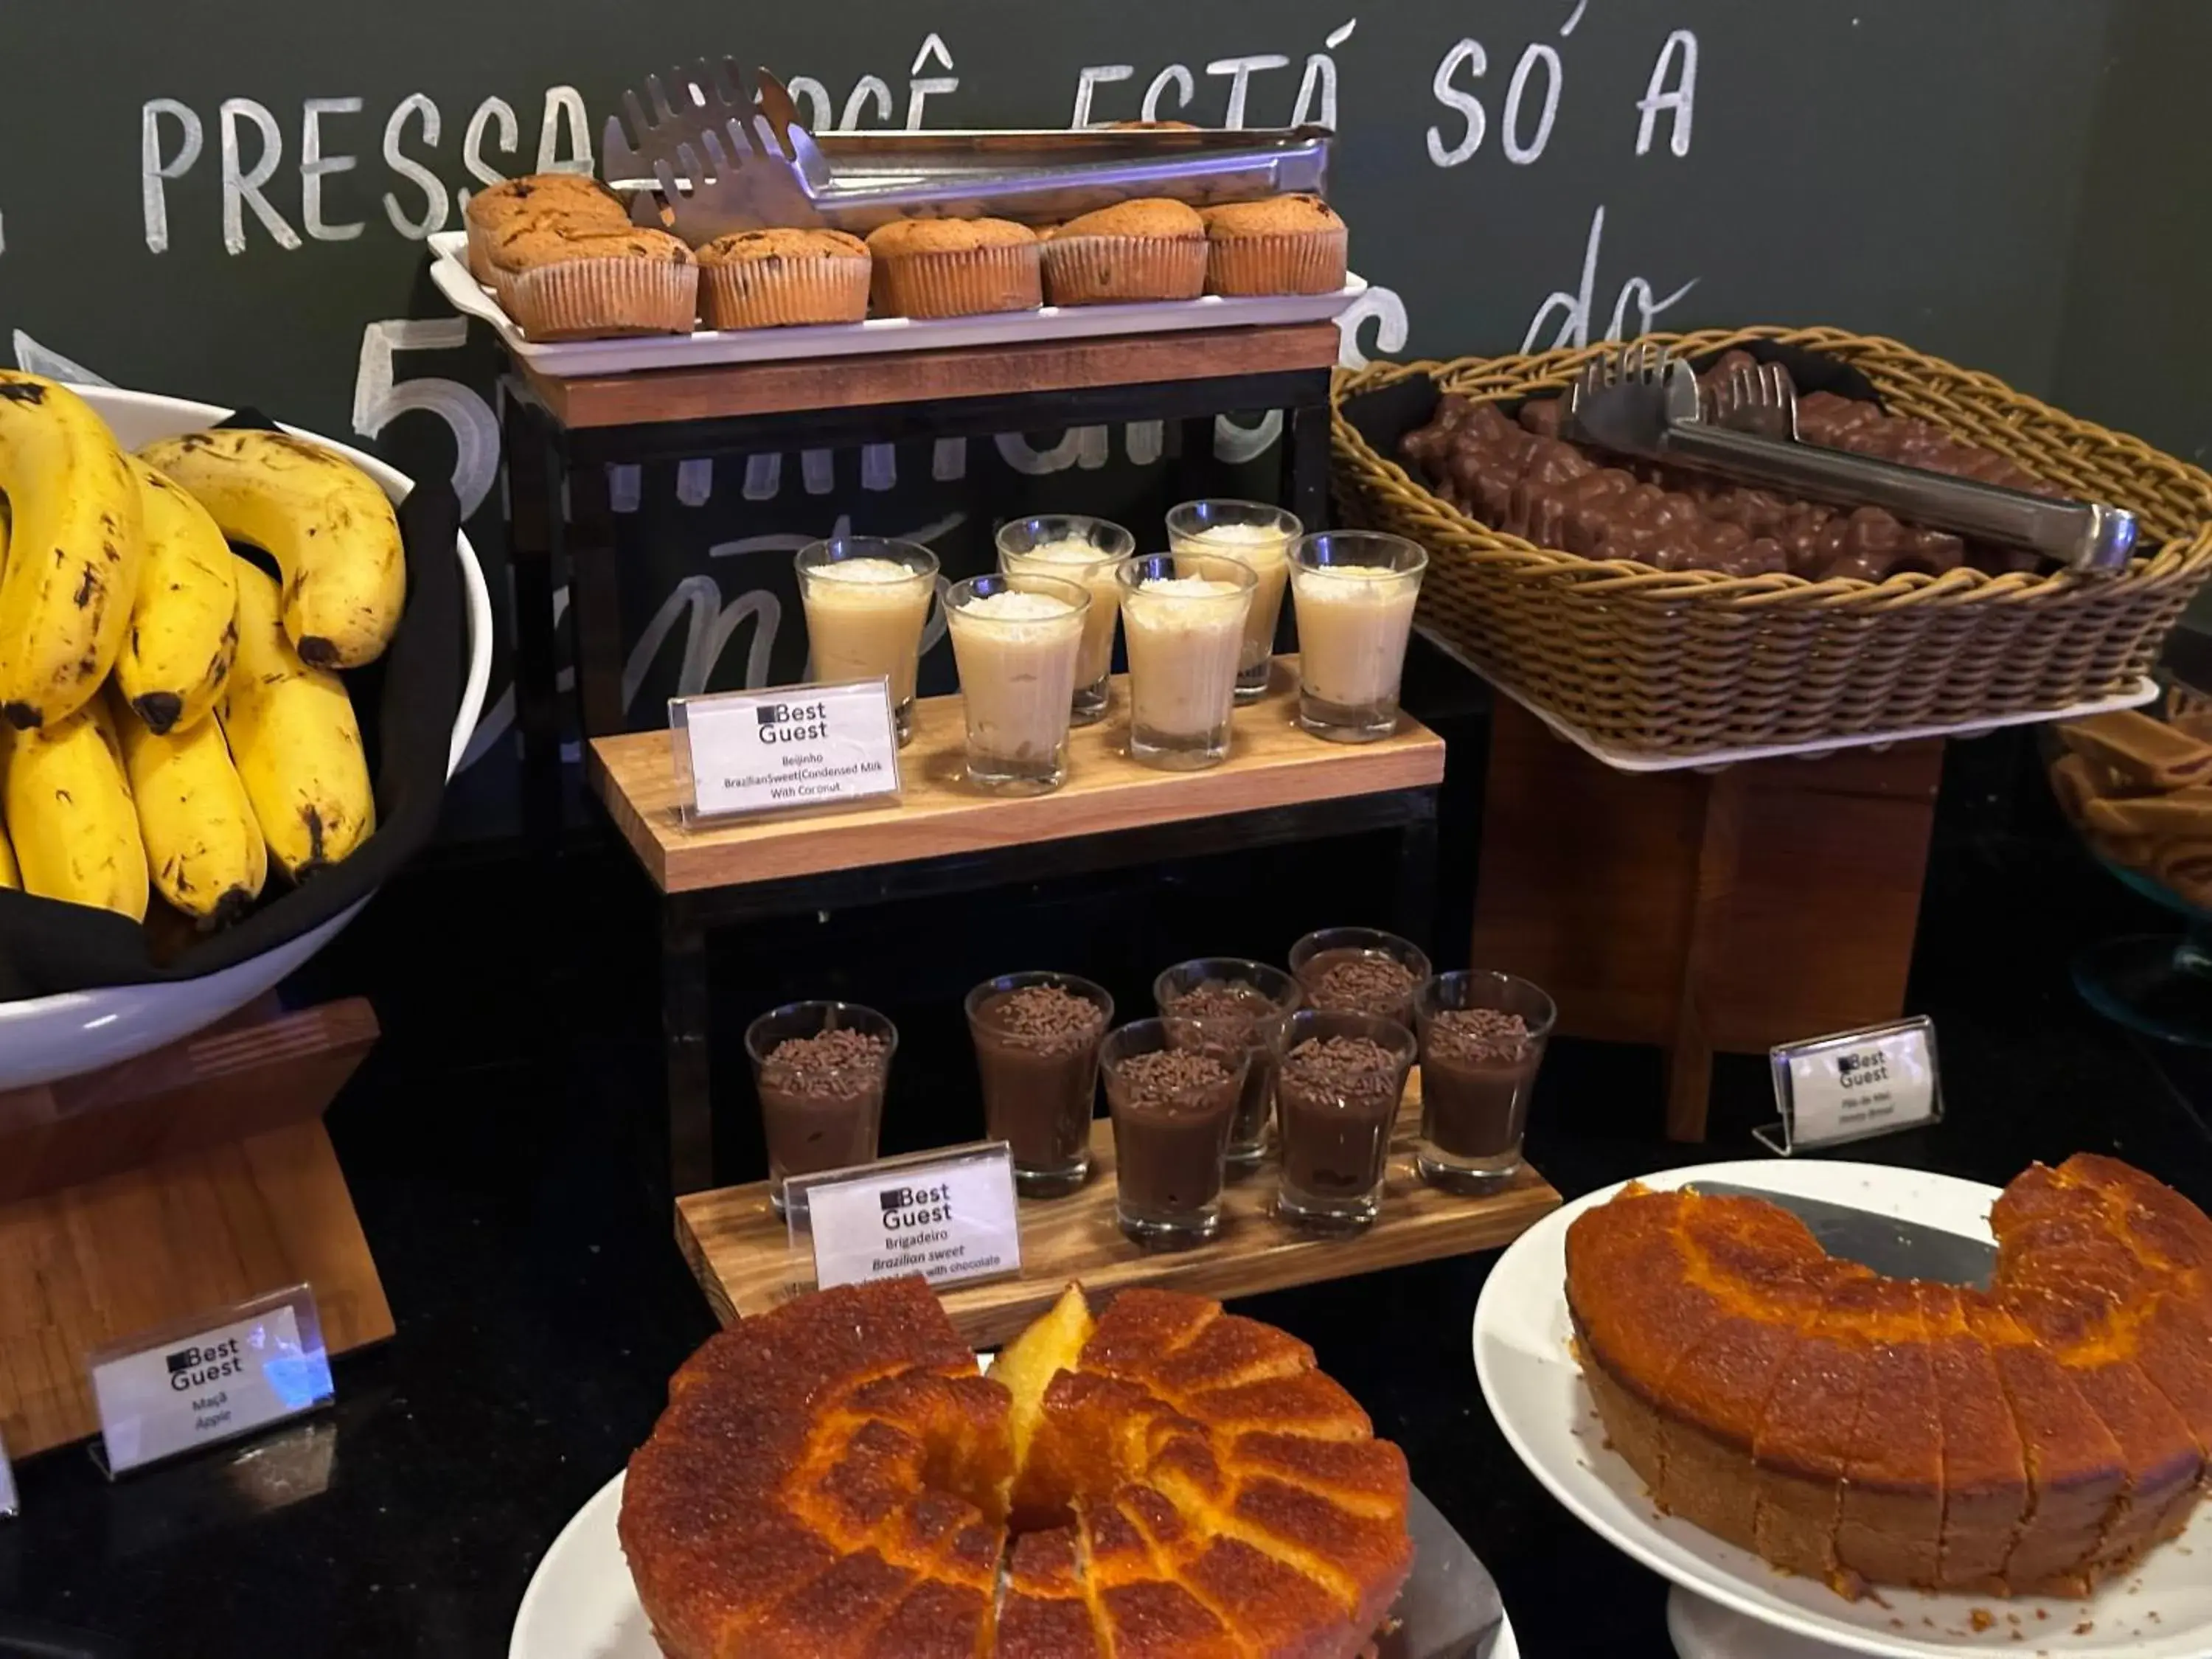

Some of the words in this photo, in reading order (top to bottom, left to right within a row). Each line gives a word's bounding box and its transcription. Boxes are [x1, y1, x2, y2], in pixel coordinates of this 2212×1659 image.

[1427, 0, 1587, 167] SÓ
[1636, 29, 1698, 156] A
[776, 702, 827, 723] Best
[759, 721, 828, 745] Guest
[771, 786, 796, 799] With
[1849, 1050, 1885, 1070] Best
[1840, 1066, 1888, 1088] Guest
[899, 1183, 951, 1207] Best
[883, 1203, 953, 1231] Guest
[886, 1229, 948, 1251] Brigadeiro
[872, 1252, 925, 1271] Brazilian
[928, 1245, 965, 1261] sweet
[186, 1338, 239, 1367] Best
[171, 1357, 244, 1391] Guest
